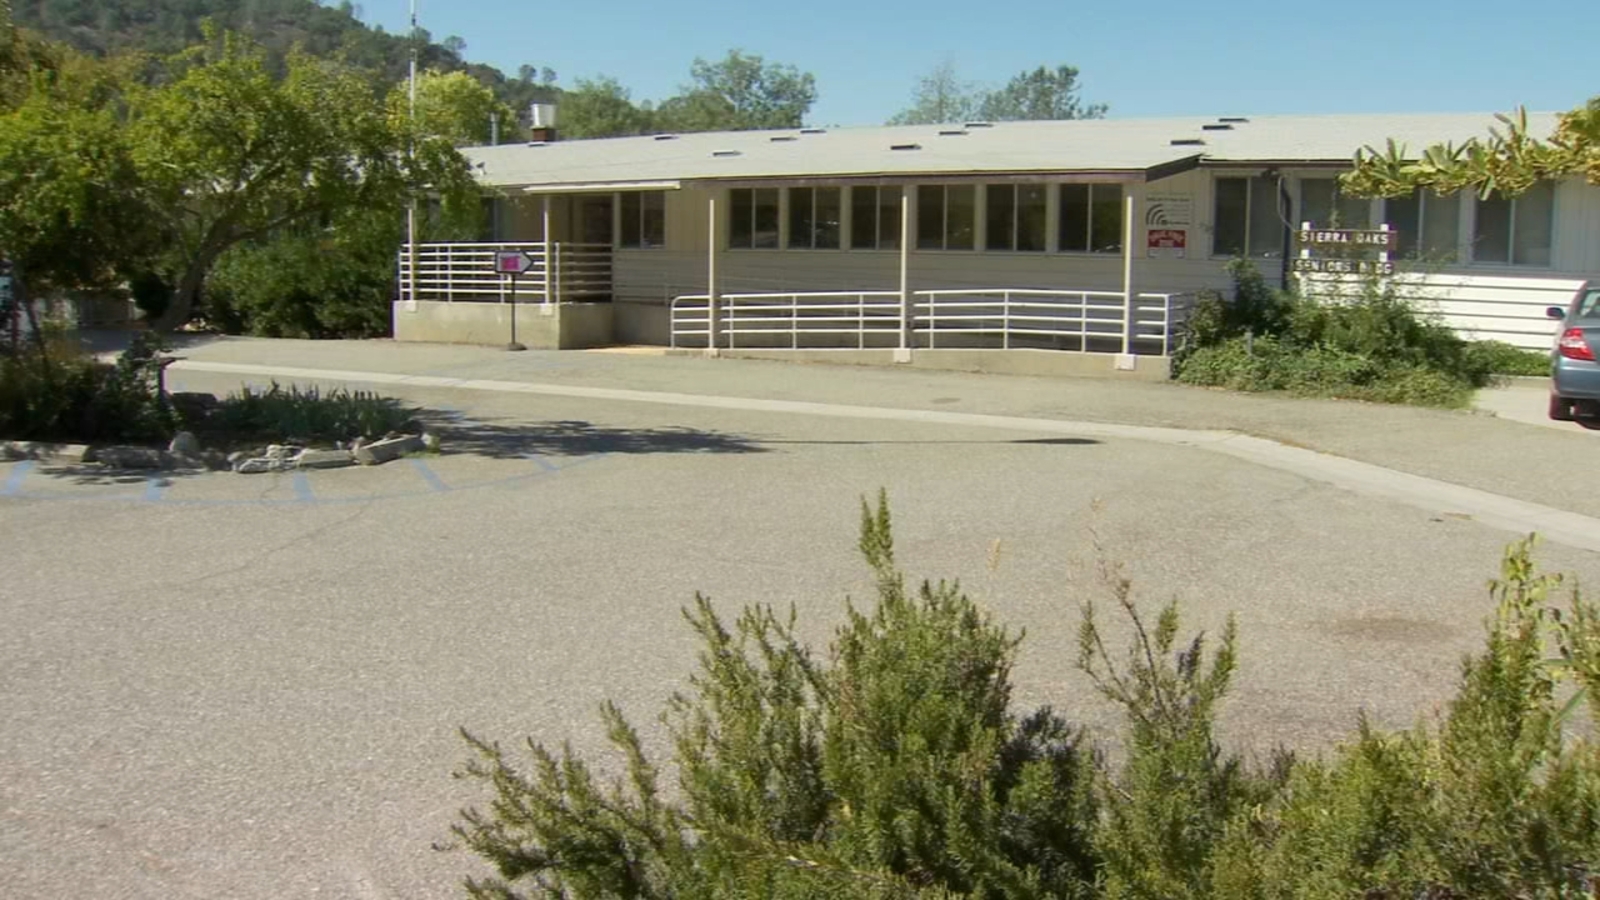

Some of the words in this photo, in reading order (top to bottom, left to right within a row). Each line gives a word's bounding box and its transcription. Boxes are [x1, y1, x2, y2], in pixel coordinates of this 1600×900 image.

[1301, 230, 1348, 244] SIERRA
[1356, 232, 1389, 245] OAKS
[1358, 260, 1393, 275] BDG
